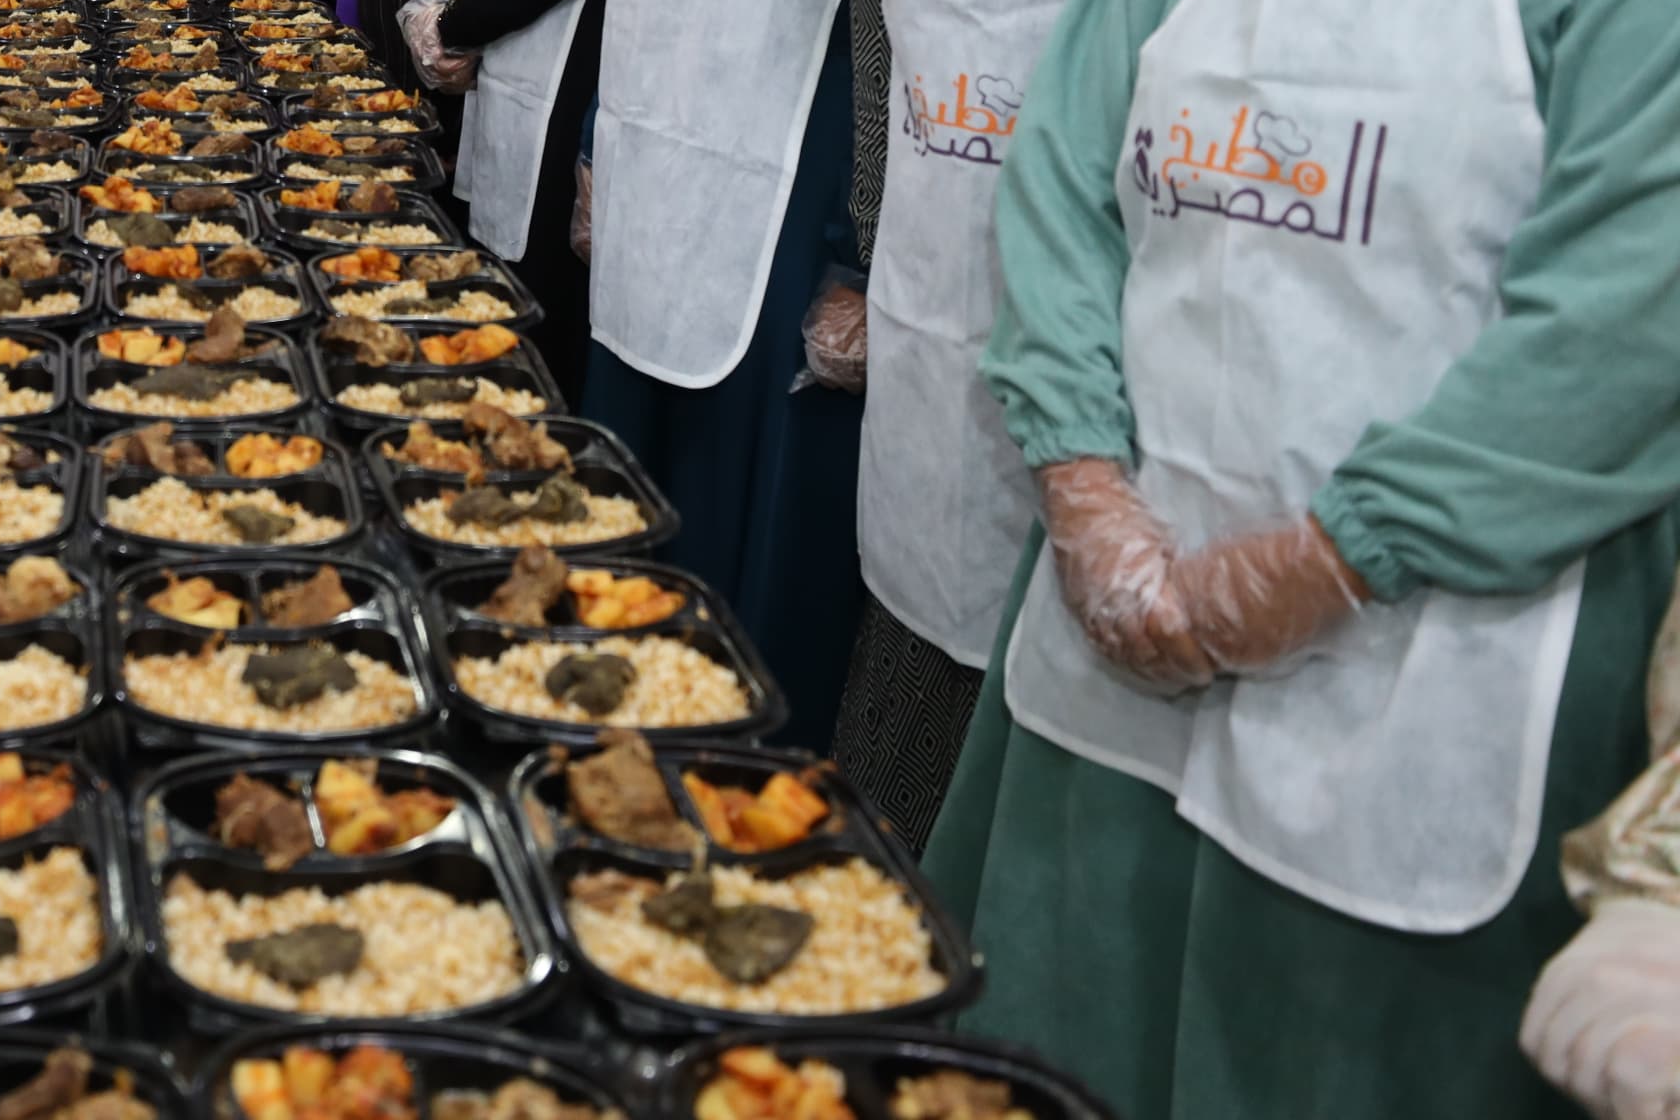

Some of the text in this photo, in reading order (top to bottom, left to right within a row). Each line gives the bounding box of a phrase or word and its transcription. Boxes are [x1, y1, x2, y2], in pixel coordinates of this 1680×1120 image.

[904, 82, 1003, 166] صرية
[1161, 105, 1329, 197] مطبخ
[1134, 119, 1388, 247] المصرية
